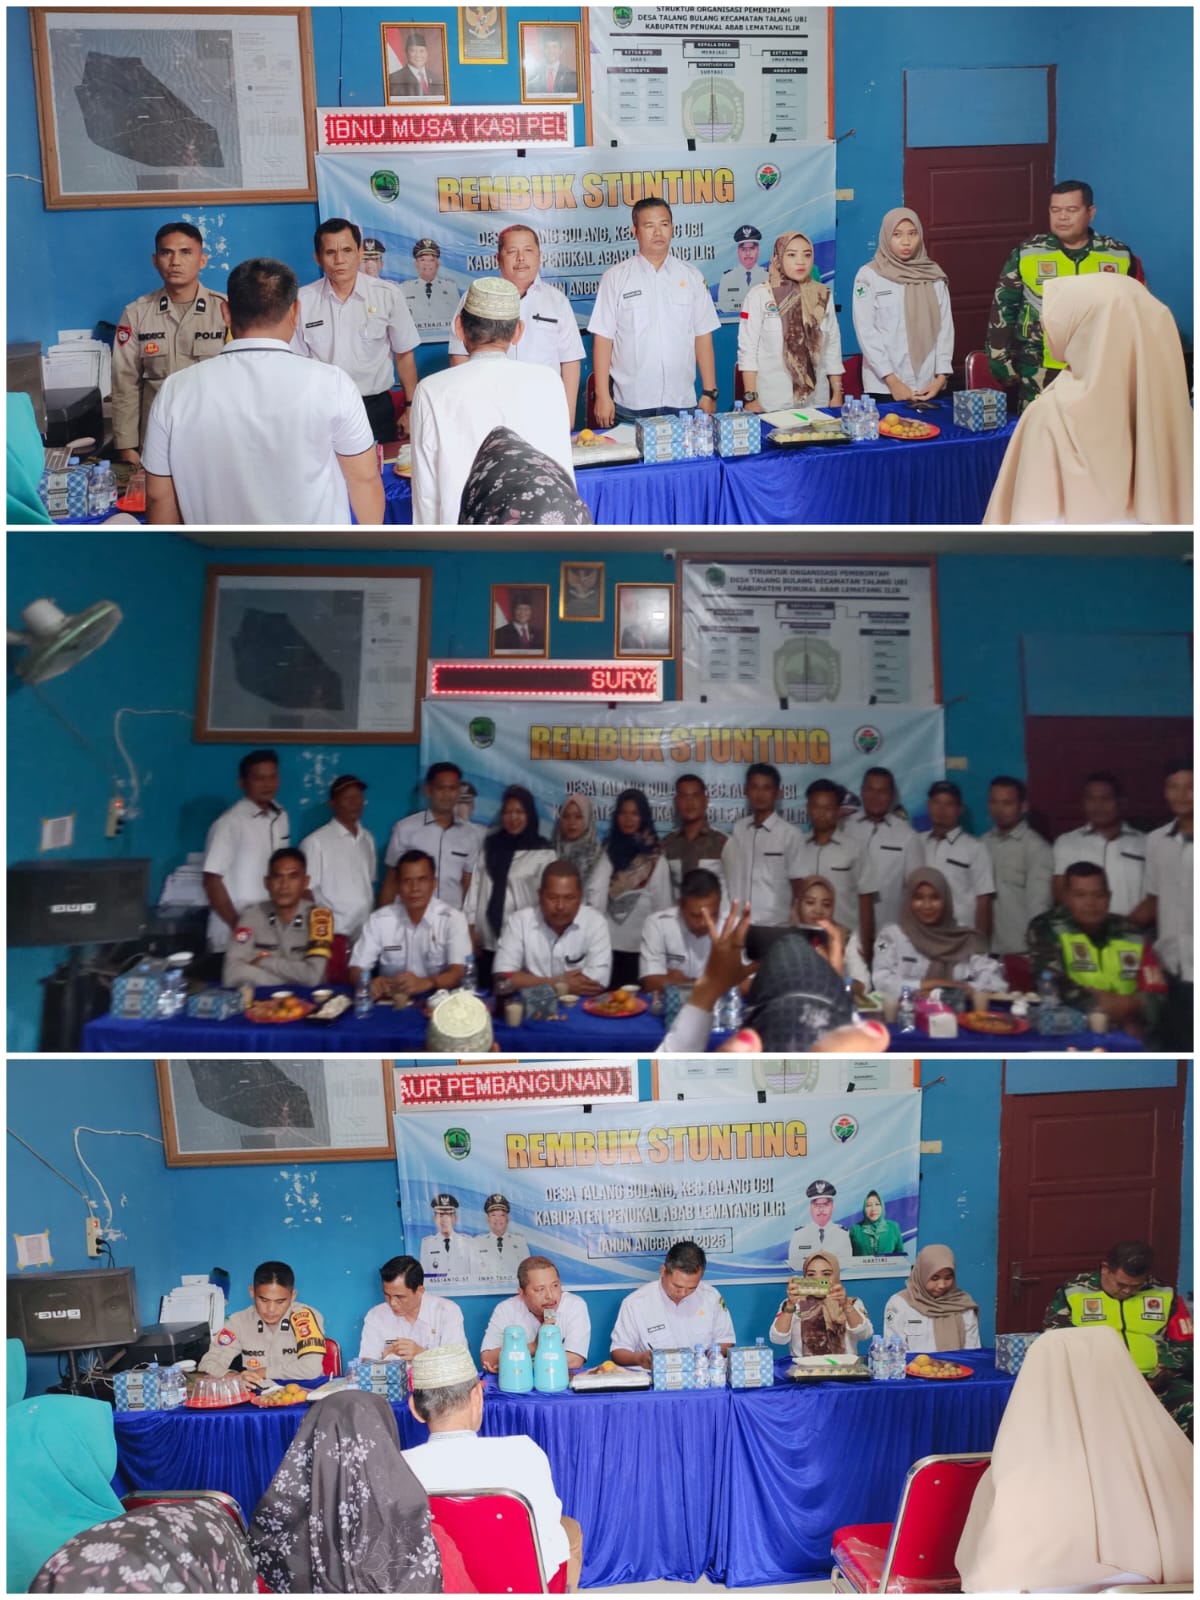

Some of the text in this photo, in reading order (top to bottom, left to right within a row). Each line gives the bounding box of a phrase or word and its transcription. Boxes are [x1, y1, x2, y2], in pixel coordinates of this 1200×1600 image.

[330, 119, 385, 139] IBNU
[392, 118, 455, 138] MUSA
[437, 168, 735, 212] REMBUK STUNTING
[685, 222, 704, 237] UBI
[542, 251, 596, 267] PENUKAL
[694, 245, 715, 260] ILIR
[530, 725, 831, 765] REMBUK STUNTING
[506, 1119, 807, 1169] REMBUK STUNTING
[545, 1186, 576, 1202] DESA
[754, 1177, 774, 1193] UBI
[535, 1201, 786, 1226] KABUPATEN PENUKAL ABAB LEMATANG ILIR
[599, 1238, 633, 1252] TAHUN
